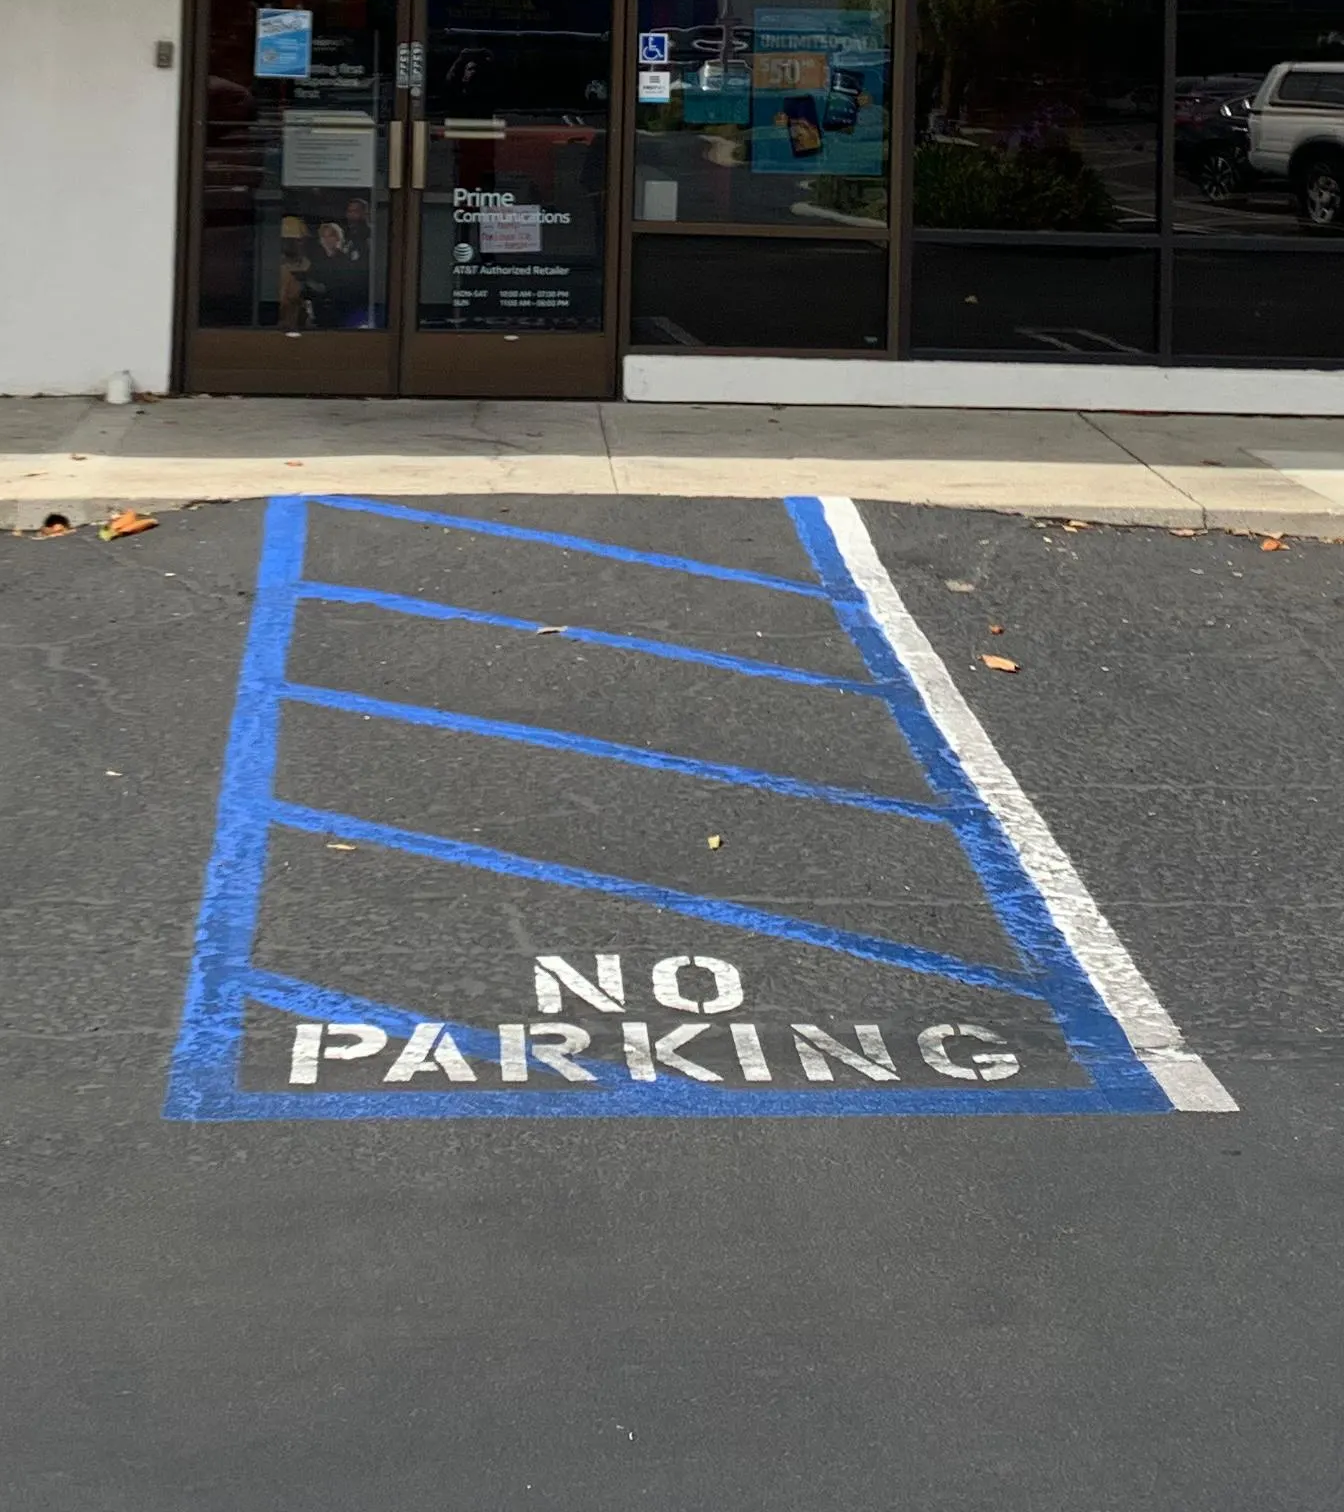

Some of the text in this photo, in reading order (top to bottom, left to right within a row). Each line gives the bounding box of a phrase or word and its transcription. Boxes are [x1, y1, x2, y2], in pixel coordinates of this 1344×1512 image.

[453, 188, 515, 207] Prime
[453, 209, 571, 224] Communications
[453, 265, 570, 276] AT&T Authorized Retailer
[534, 954, 743, 1014] NO
[288, 1022, 1020, 1084] PARKING
